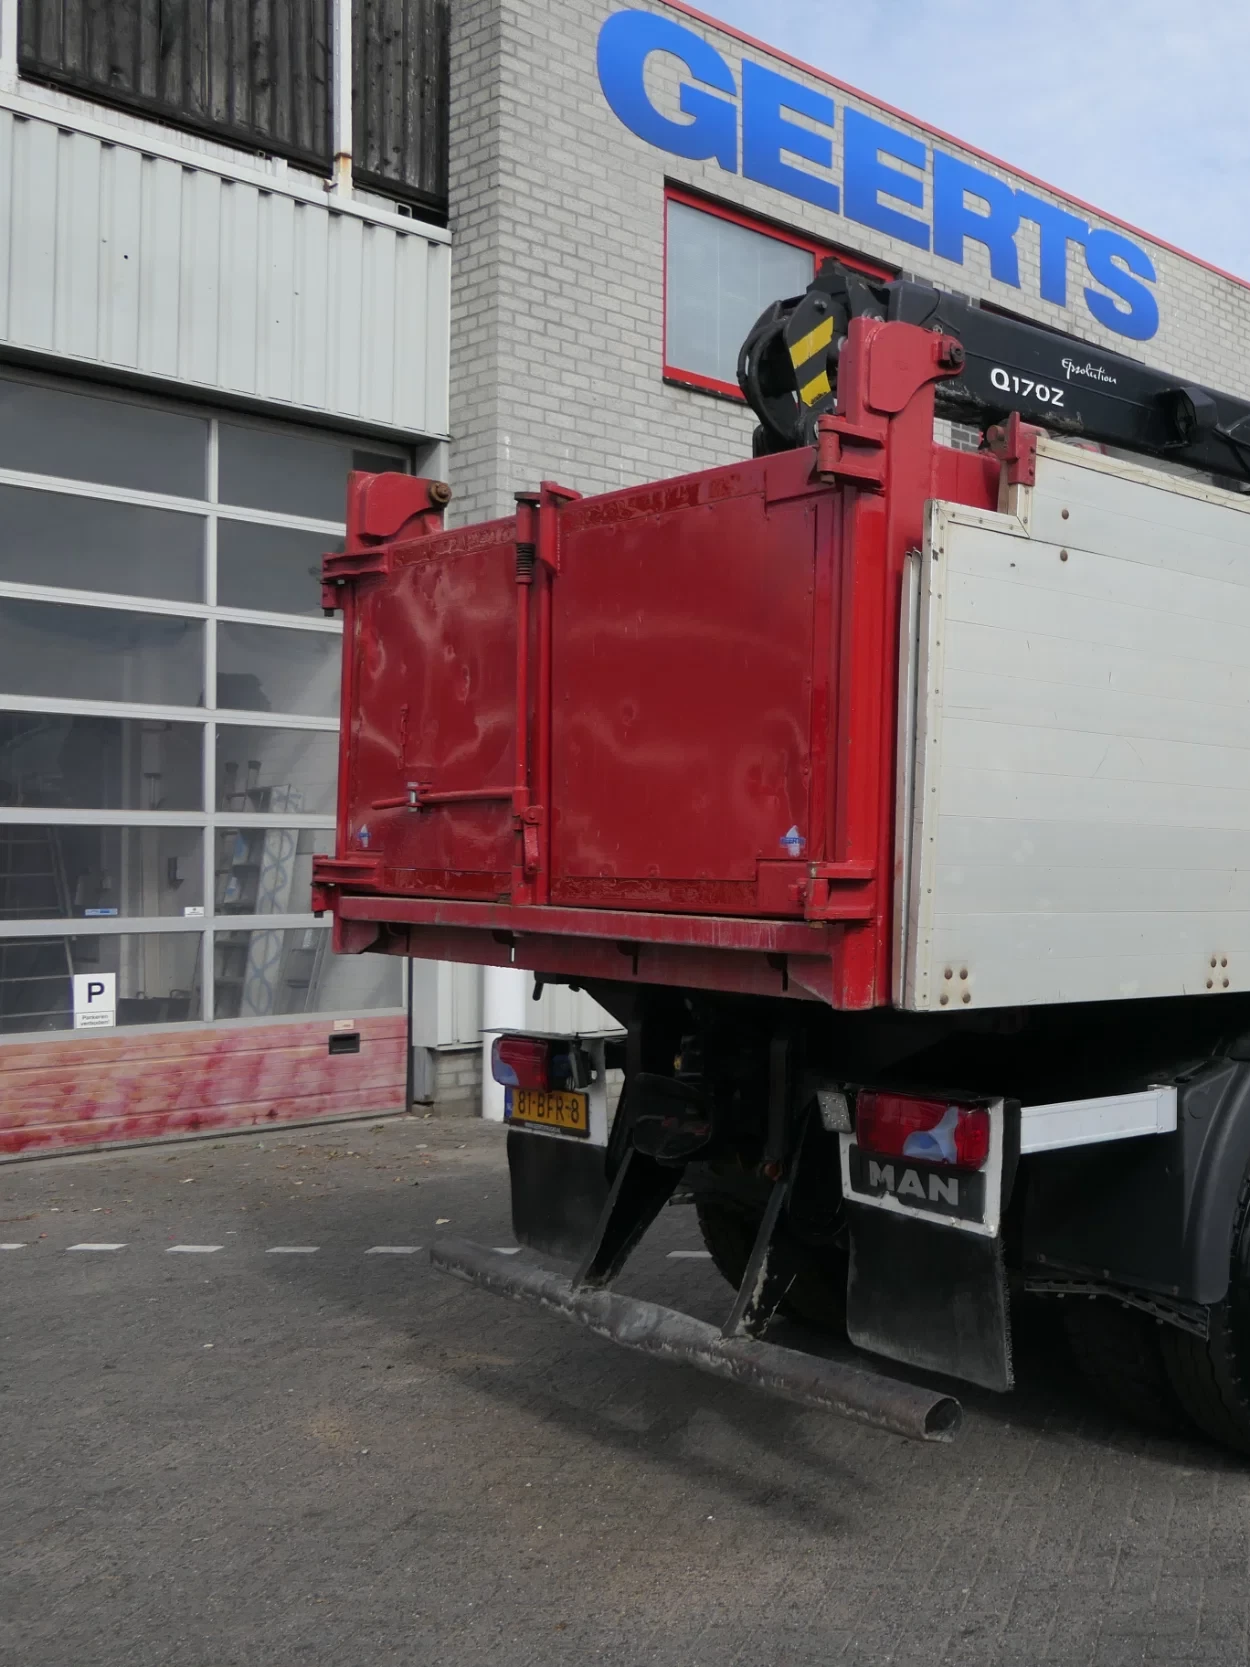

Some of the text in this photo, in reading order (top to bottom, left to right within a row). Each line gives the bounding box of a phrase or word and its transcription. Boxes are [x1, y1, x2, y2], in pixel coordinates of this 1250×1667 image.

[597, 9, 1159, 341] GEERTS
[990, 368, 1064, 407] Q170Z
[1061, 358, 1117, 384] Epsolution
[88, 982, 105, 1003] P
[518, 1090, 580, 1124] 81-BFR-8
[868, 1160, 959, 1206] MAN
